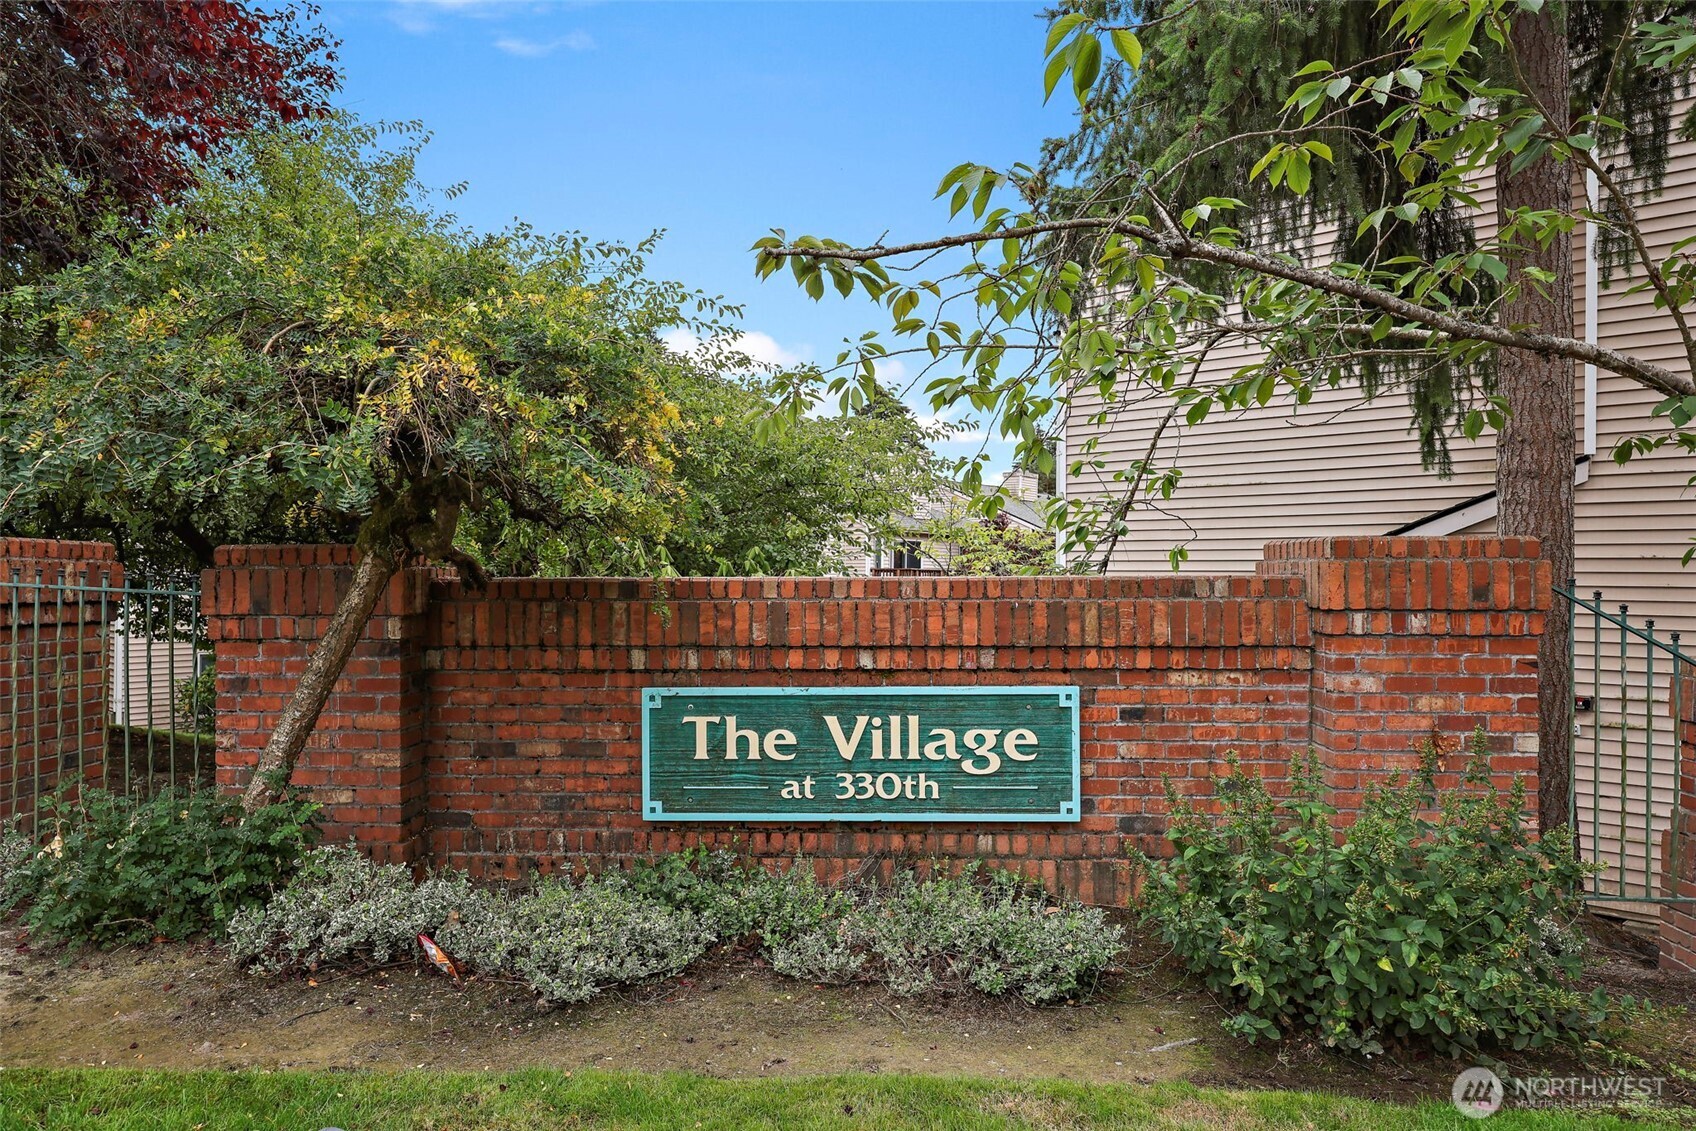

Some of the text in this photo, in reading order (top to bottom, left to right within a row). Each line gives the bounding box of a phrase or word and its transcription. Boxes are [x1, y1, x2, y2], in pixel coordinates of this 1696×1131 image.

[682, 714, 1039, 775] The Village
[780, 773, 940, 800] at 330th
